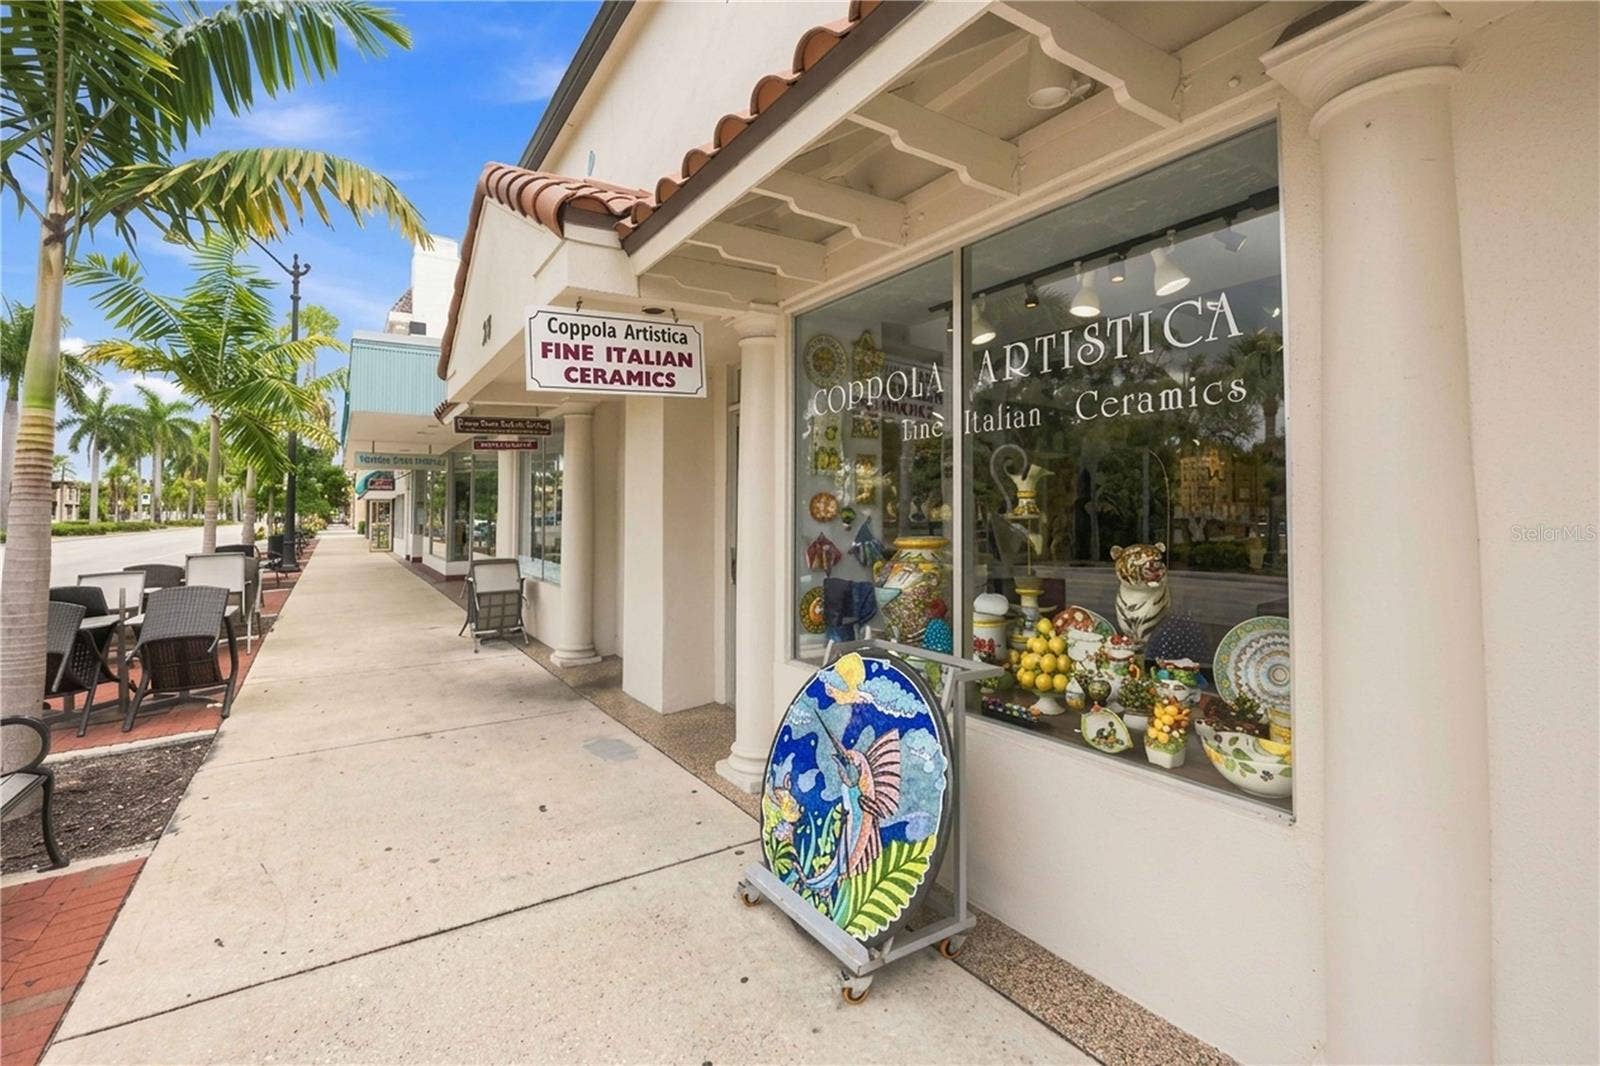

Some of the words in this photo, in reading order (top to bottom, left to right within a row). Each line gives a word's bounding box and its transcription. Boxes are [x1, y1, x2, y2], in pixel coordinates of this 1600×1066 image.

[547, 316, 617, 341] Coppola
[624, 323, 689, 345] Artistica
[541, 341, 595, 362] FINE
[605, 346, 694, 369] ITALIAN
[813, 361, 944, 416] COPPOLA
[977, 291, 1244, 386] ARTISTICA
[563, 366, 676, 388] CERAMICS
[964, 403, 1042, 434] Italian
[1075, 376, 1248, 421] Ceramics
